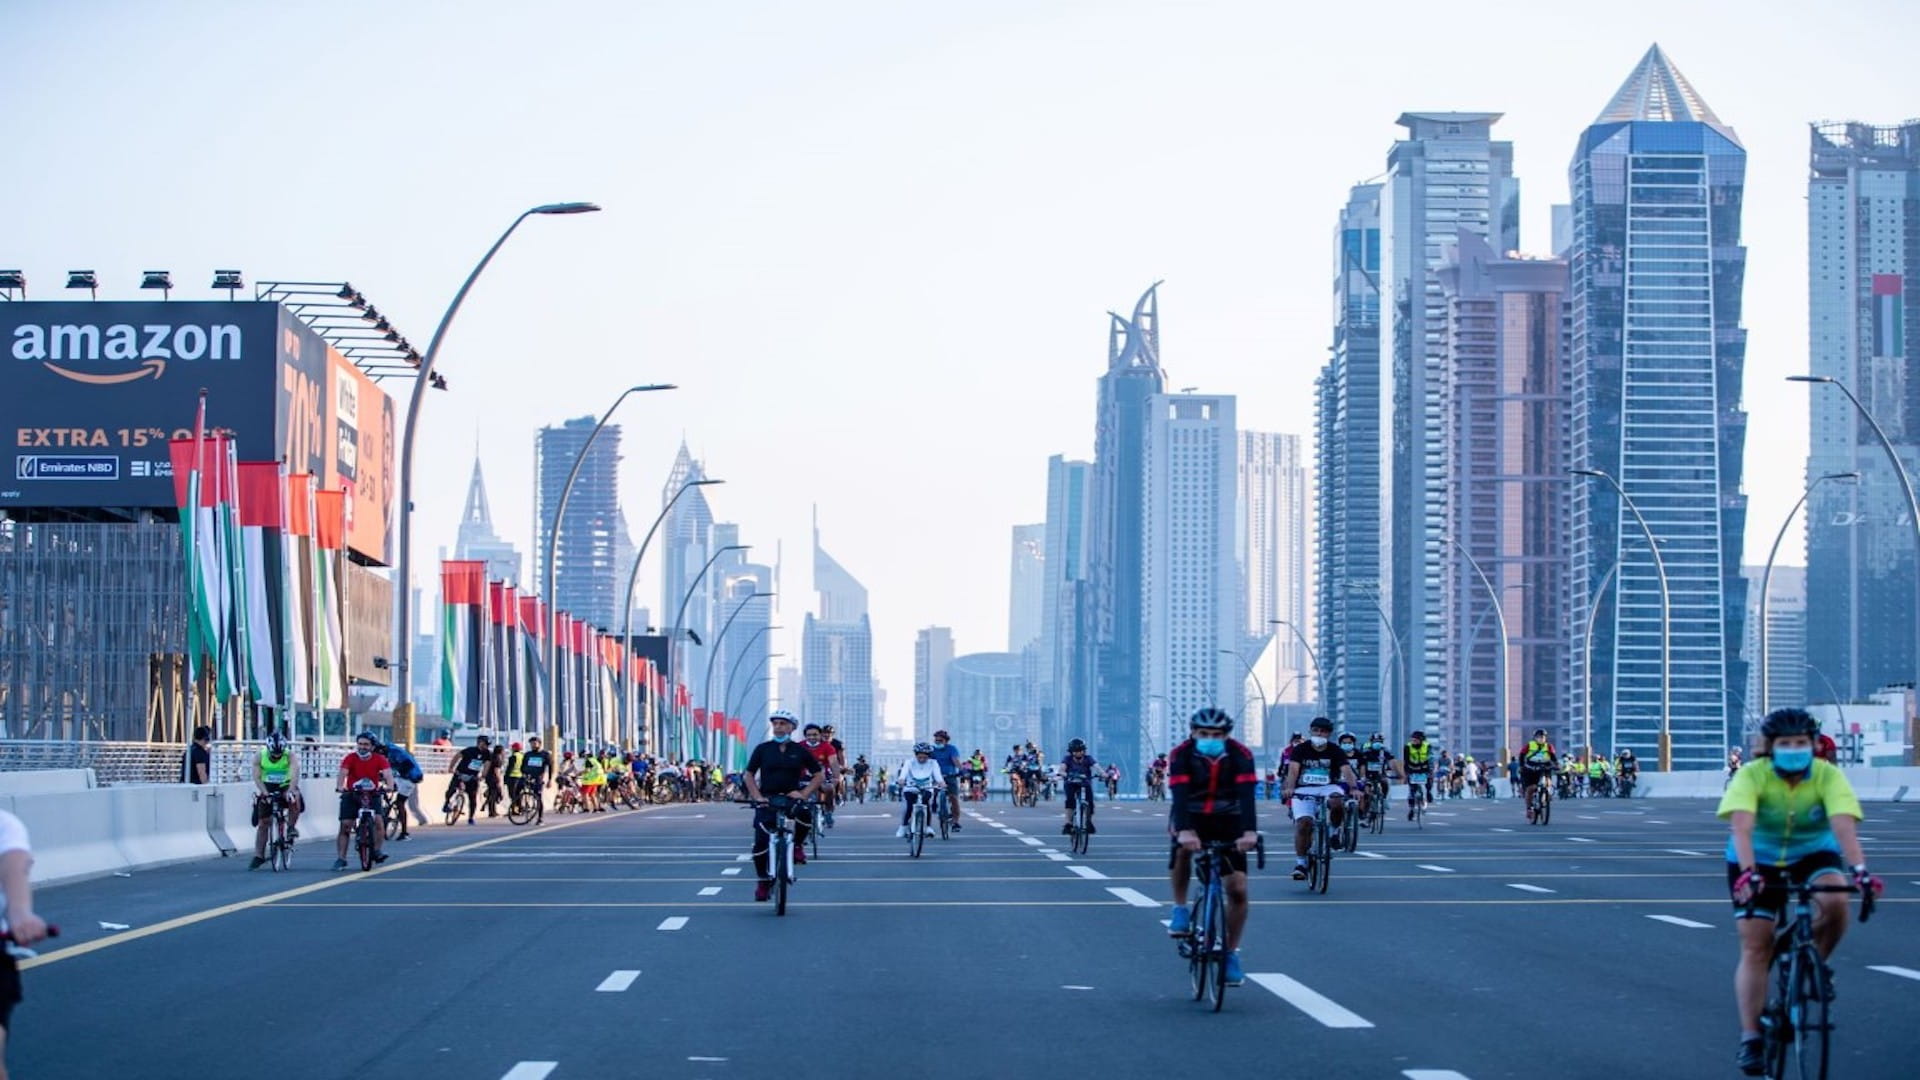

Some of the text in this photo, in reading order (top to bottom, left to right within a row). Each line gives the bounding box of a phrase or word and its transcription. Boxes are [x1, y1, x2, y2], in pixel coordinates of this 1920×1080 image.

[11, 323, 242, 360] amazon
[17, 427, 110, 447] EXTRA
[117, 427, 165, 447] 15%
[40, 461, 113, 472] Emirates NBD
